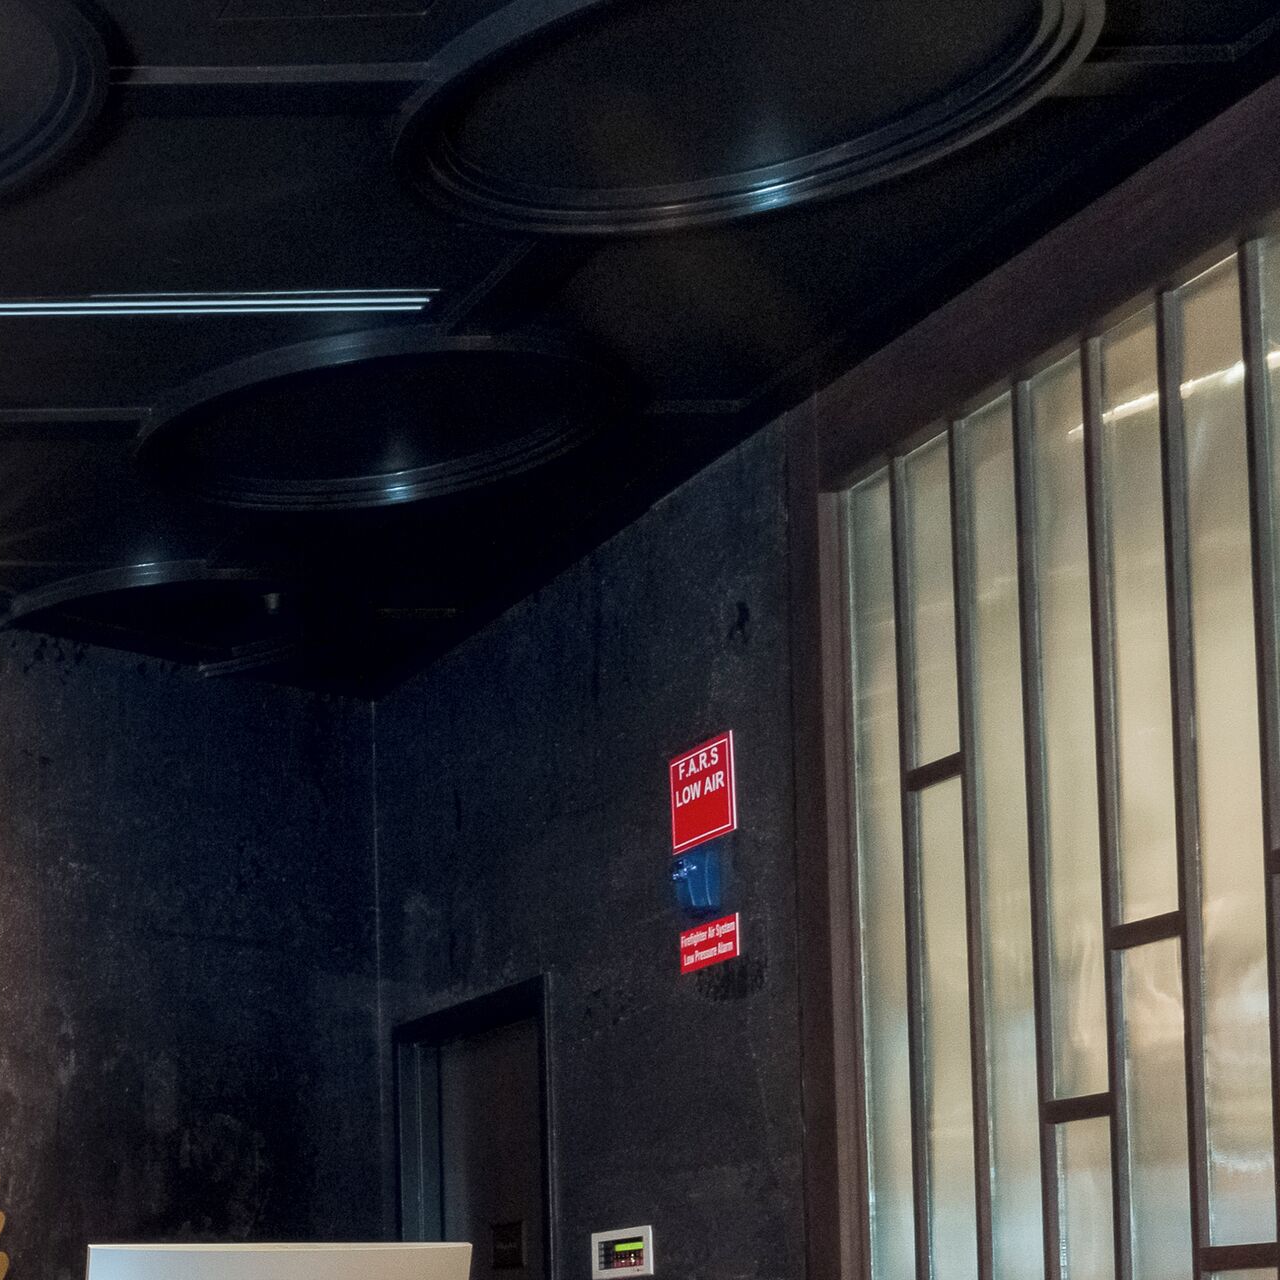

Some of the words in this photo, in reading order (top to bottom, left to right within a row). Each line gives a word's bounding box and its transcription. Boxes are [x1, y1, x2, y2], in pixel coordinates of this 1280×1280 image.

[679, 747, 718, 780] F.A.R.S
[676, 781, 701, 808] LOW
[704, 771, 724, 795] AIR
[684, 954, 694, 966] Low
[695, 947, 717, 962] Pressure
